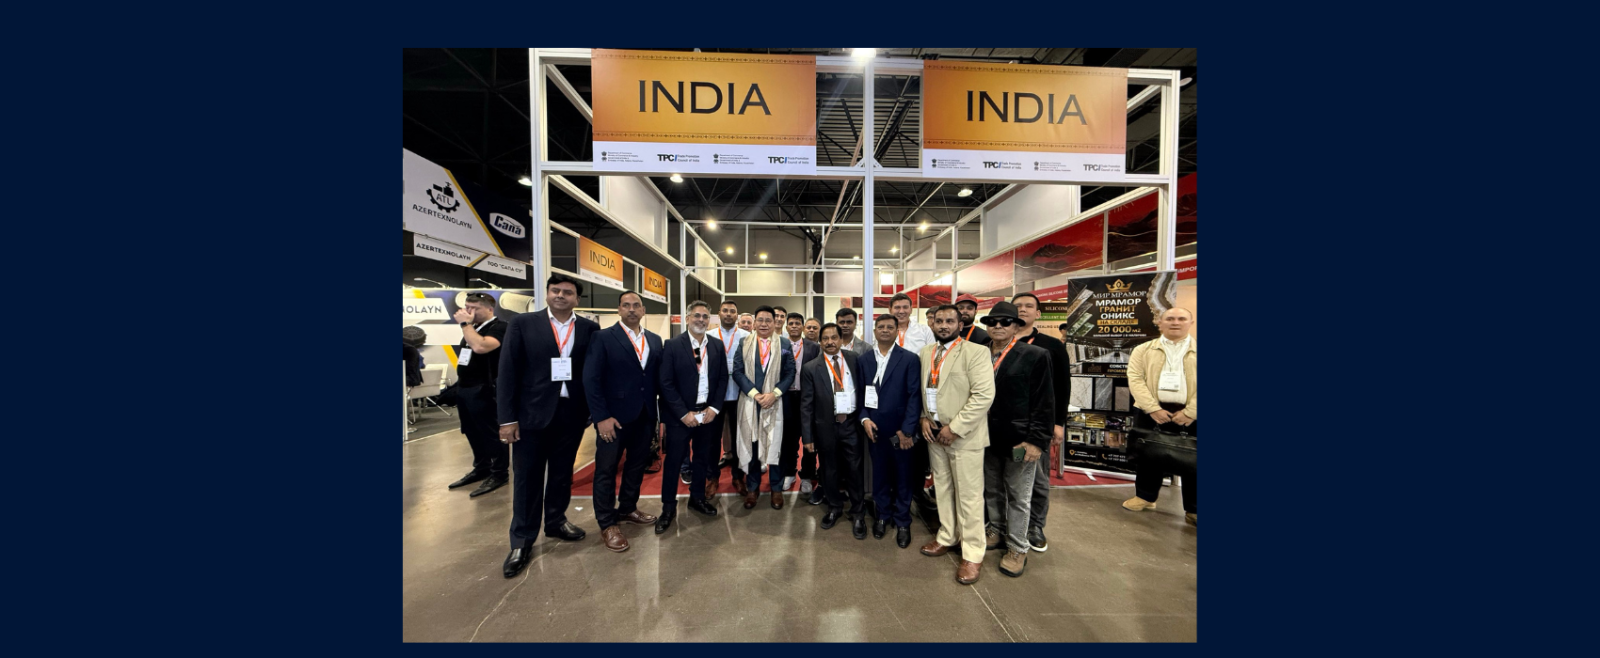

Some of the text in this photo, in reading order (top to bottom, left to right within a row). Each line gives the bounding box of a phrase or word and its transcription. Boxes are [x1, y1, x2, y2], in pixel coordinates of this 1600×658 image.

[638, 80, 772, 116] INDIA
[967, 90, 1087, 125] INDIA
[436, 193, 451, 206] ATL
[412, 204, 472, 229] AZERTEXNOLAYN
[416, 242, 471, 261] AZERTEXNOLAYN
[590, 250, 616, 271] INDIA
[649, 277, 662, 289] INDIA
[1096, 298, 1141, 306] МРАМОР
